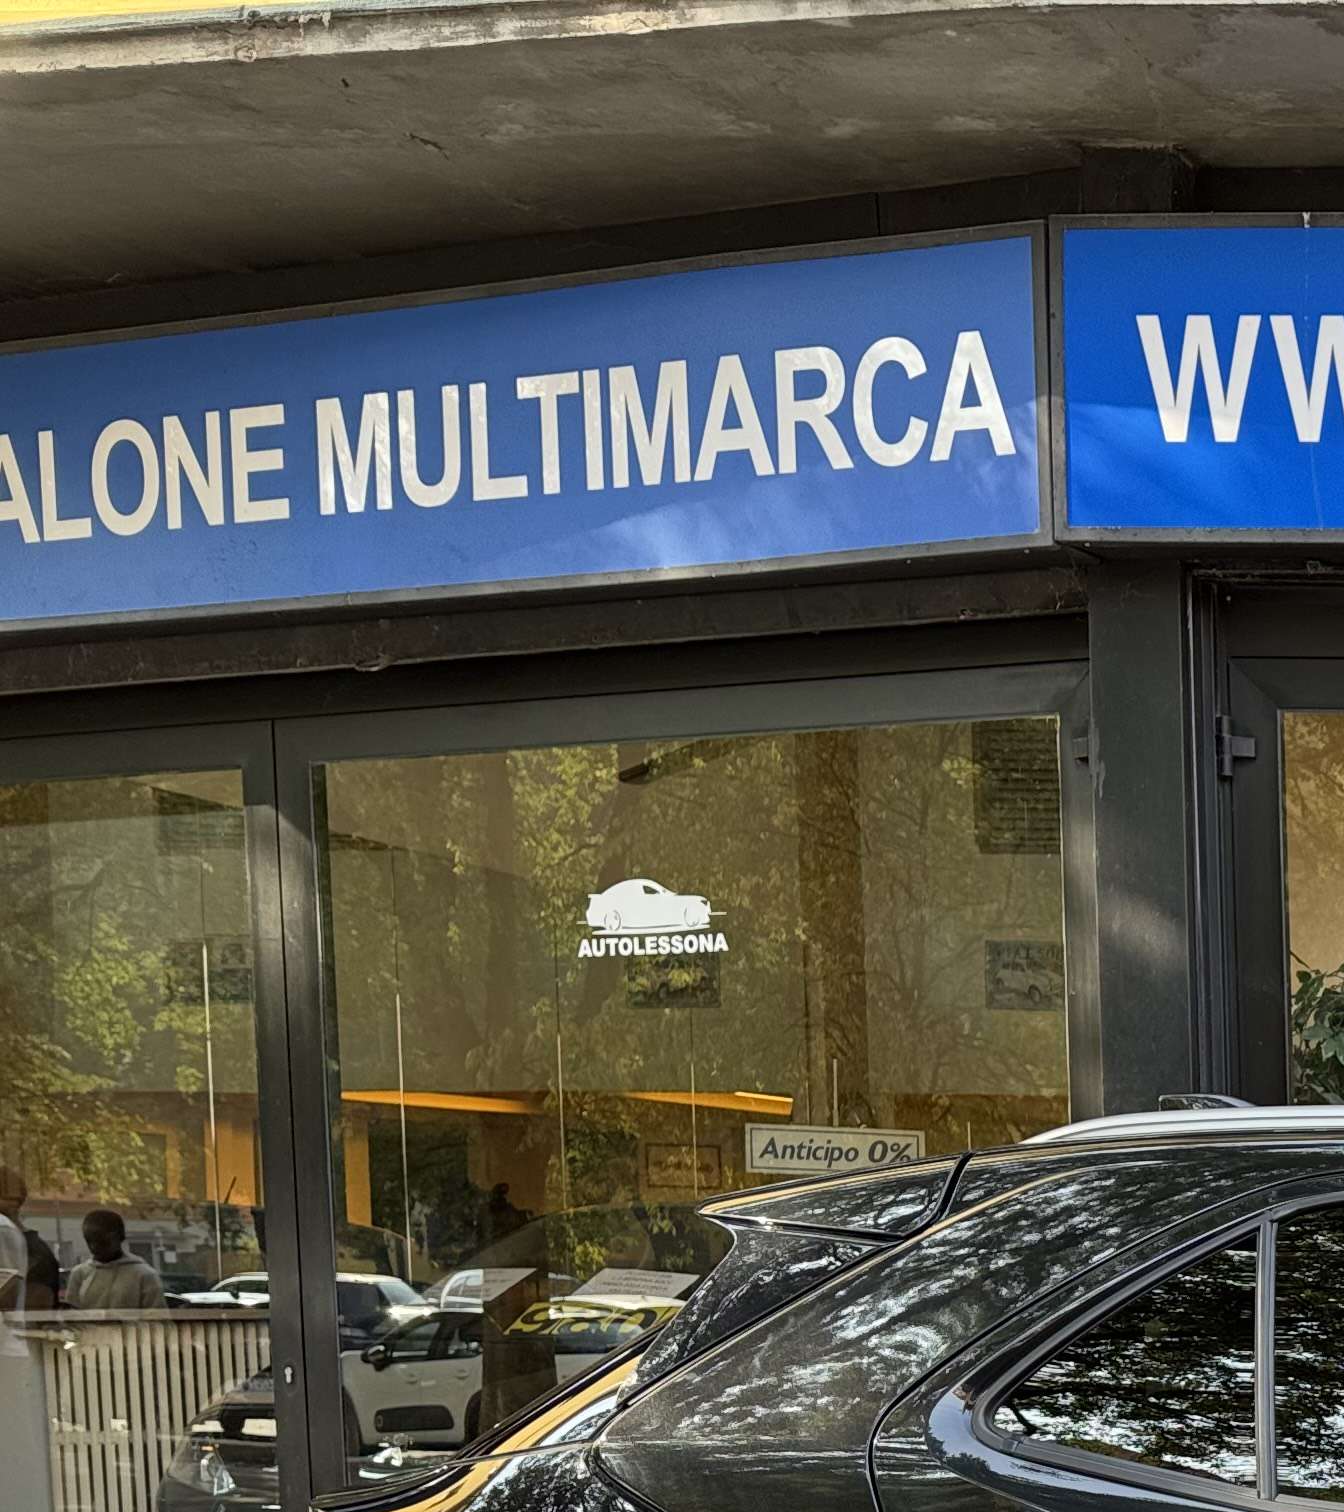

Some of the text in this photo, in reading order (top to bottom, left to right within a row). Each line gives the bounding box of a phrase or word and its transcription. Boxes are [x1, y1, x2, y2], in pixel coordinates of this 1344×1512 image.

[314, 330, 1016, 516] MULTIMARCA
[577, 932, 729, 958] AUTOLESSONA
[759, 1137, 913, 1168] Anticipo 0%
